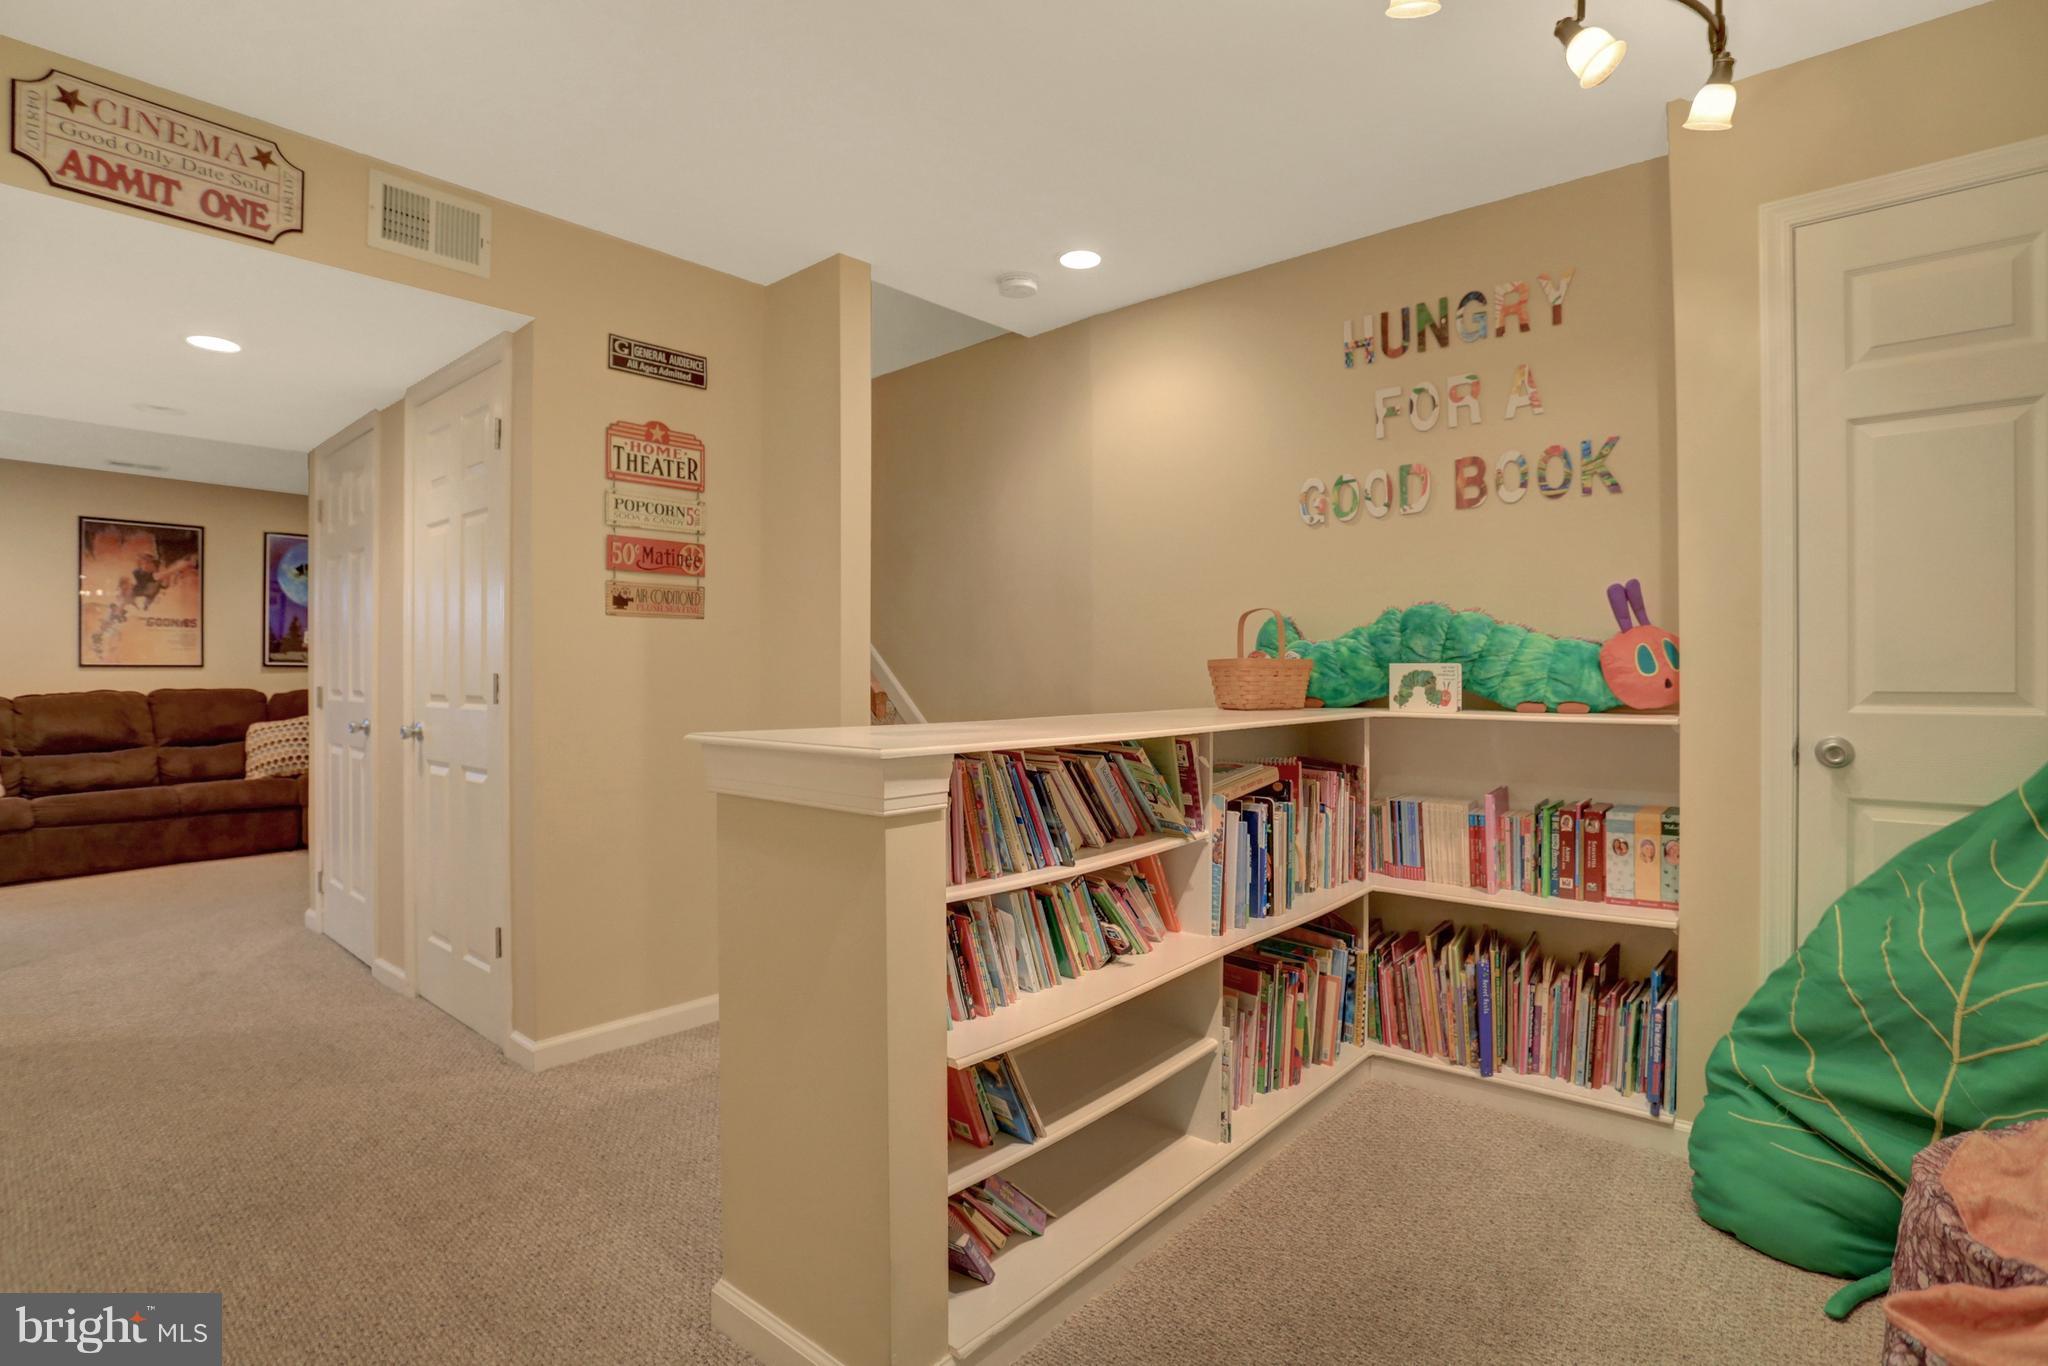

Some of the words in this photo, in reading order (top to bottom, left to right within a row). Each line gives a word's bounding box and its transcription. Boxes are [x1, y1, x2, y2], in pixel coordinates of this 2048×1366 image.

[59, 119, 117, 149] Good
[125, 141, 174, 166] Only
[181, 158, 225, 181] Date
[230, 173, 270, 195] Sold
[91, 98, 249, 167] CINEMA
[56, 149, 182, 207] ADMIT
[200, 188, 271, 232] ONE
[1343, 267, 1576, 368] HUNGRY
[614, 340, 630, 355] G
[634, 346, 667, 363] GENERAL
[669, 354, 704, 372] AUDIENCE
[627, 359, 638, 369] All
[640, 361, 658, 374] Ages
[659, 367, 692, 381] Admitted
[1374, 373, 1482, 439] FOR
[1504, 364, 1544, 420] A
[613, 445, 698, 481] THEATER
[630, 441, 682, 460] HOME
[1299, 463, 1432, 526] GOOD
[1454, 436, 1623, 510] BOOK
[614, 498, 685, 518] POPCORN
[642, 546, 701, 568] Matinee
